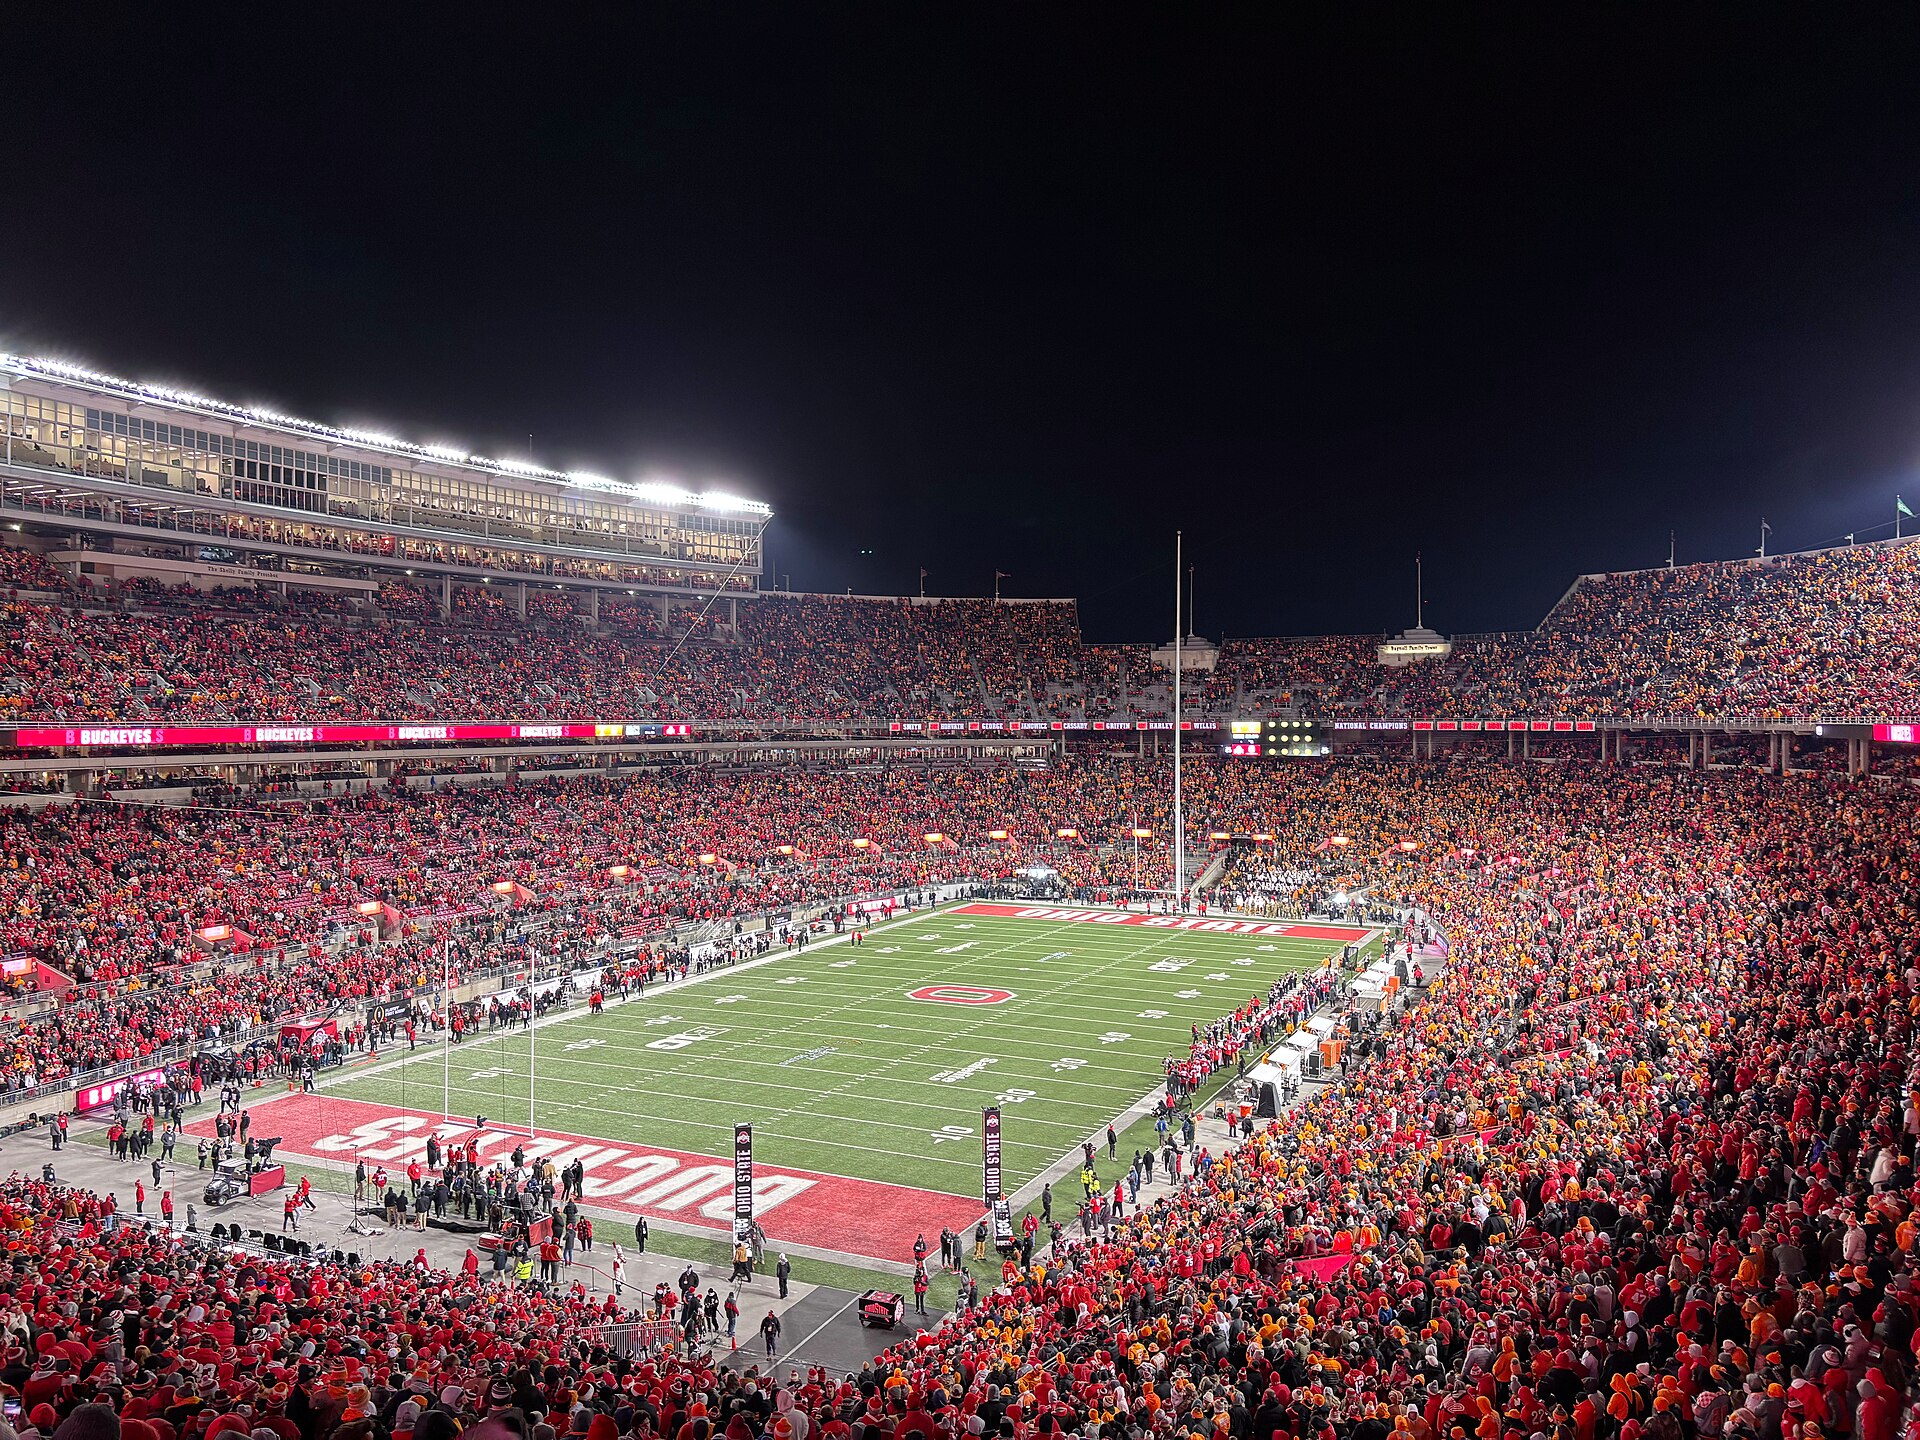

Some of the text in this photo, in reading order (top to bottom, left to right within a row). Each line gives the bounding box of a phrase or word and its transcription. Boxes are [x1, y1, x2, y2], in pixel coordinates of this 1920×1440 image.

[238, 569, 255, 577] Family
[398, 726, 448, 739] BUCKEYES
[520, 726, 563, 737] BUCKEYES
[1334, 722, 1408, 730] NATIONAL CHAMPIONS
[80, 729, 152, 744] BUCKEYES
[256, 728, 314, 742] BUCKEYES
[1014, 908, 1294, 936] OHIO STATE
[1050, 1058, 1088, 1070] 30
[994, 1088, 1036, 1103] 20
[930, 1126, 975, 1142] 10
[986, 1132, 1000, 1164] STATE
[737, 1150, 751, 1182] STATE
[986, 1167, 1000, 1194] OHIO
[737, 1186, 751, 1212] OHIO
[1185, 1257, 1194, 1267] 75
[1632, 1292, 1646, 1305] 47
[874, 1302, 890, 1316] STATE
[1531, 1410, 1546, 1426] 22
